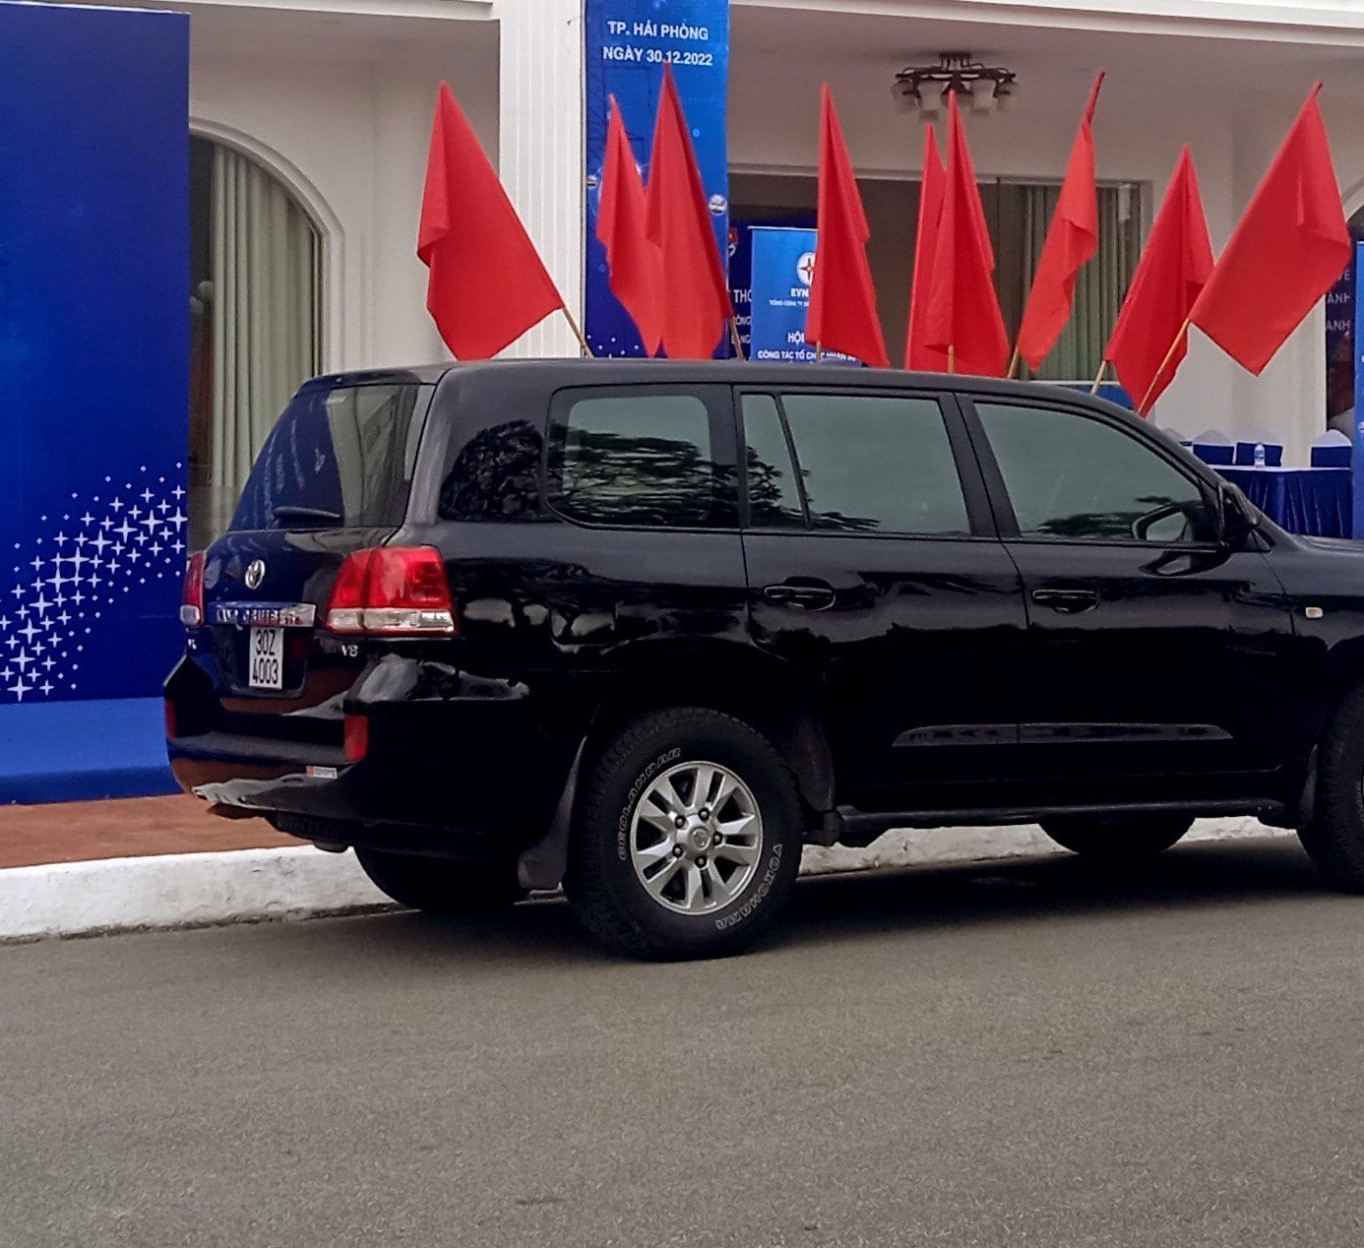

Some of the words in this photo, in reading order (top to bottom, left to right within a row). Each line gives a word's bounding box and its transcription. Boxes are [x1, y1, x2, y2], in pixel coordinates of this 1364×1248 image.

[608, 21, 630, 35] TP.
[661, 23, 708, 40] PHÒNG
[603, 45, 643, 61] NGÀY
[647, 49, 712, 66] 30.12.2022
[255, 628, 276, 656] 30Z
